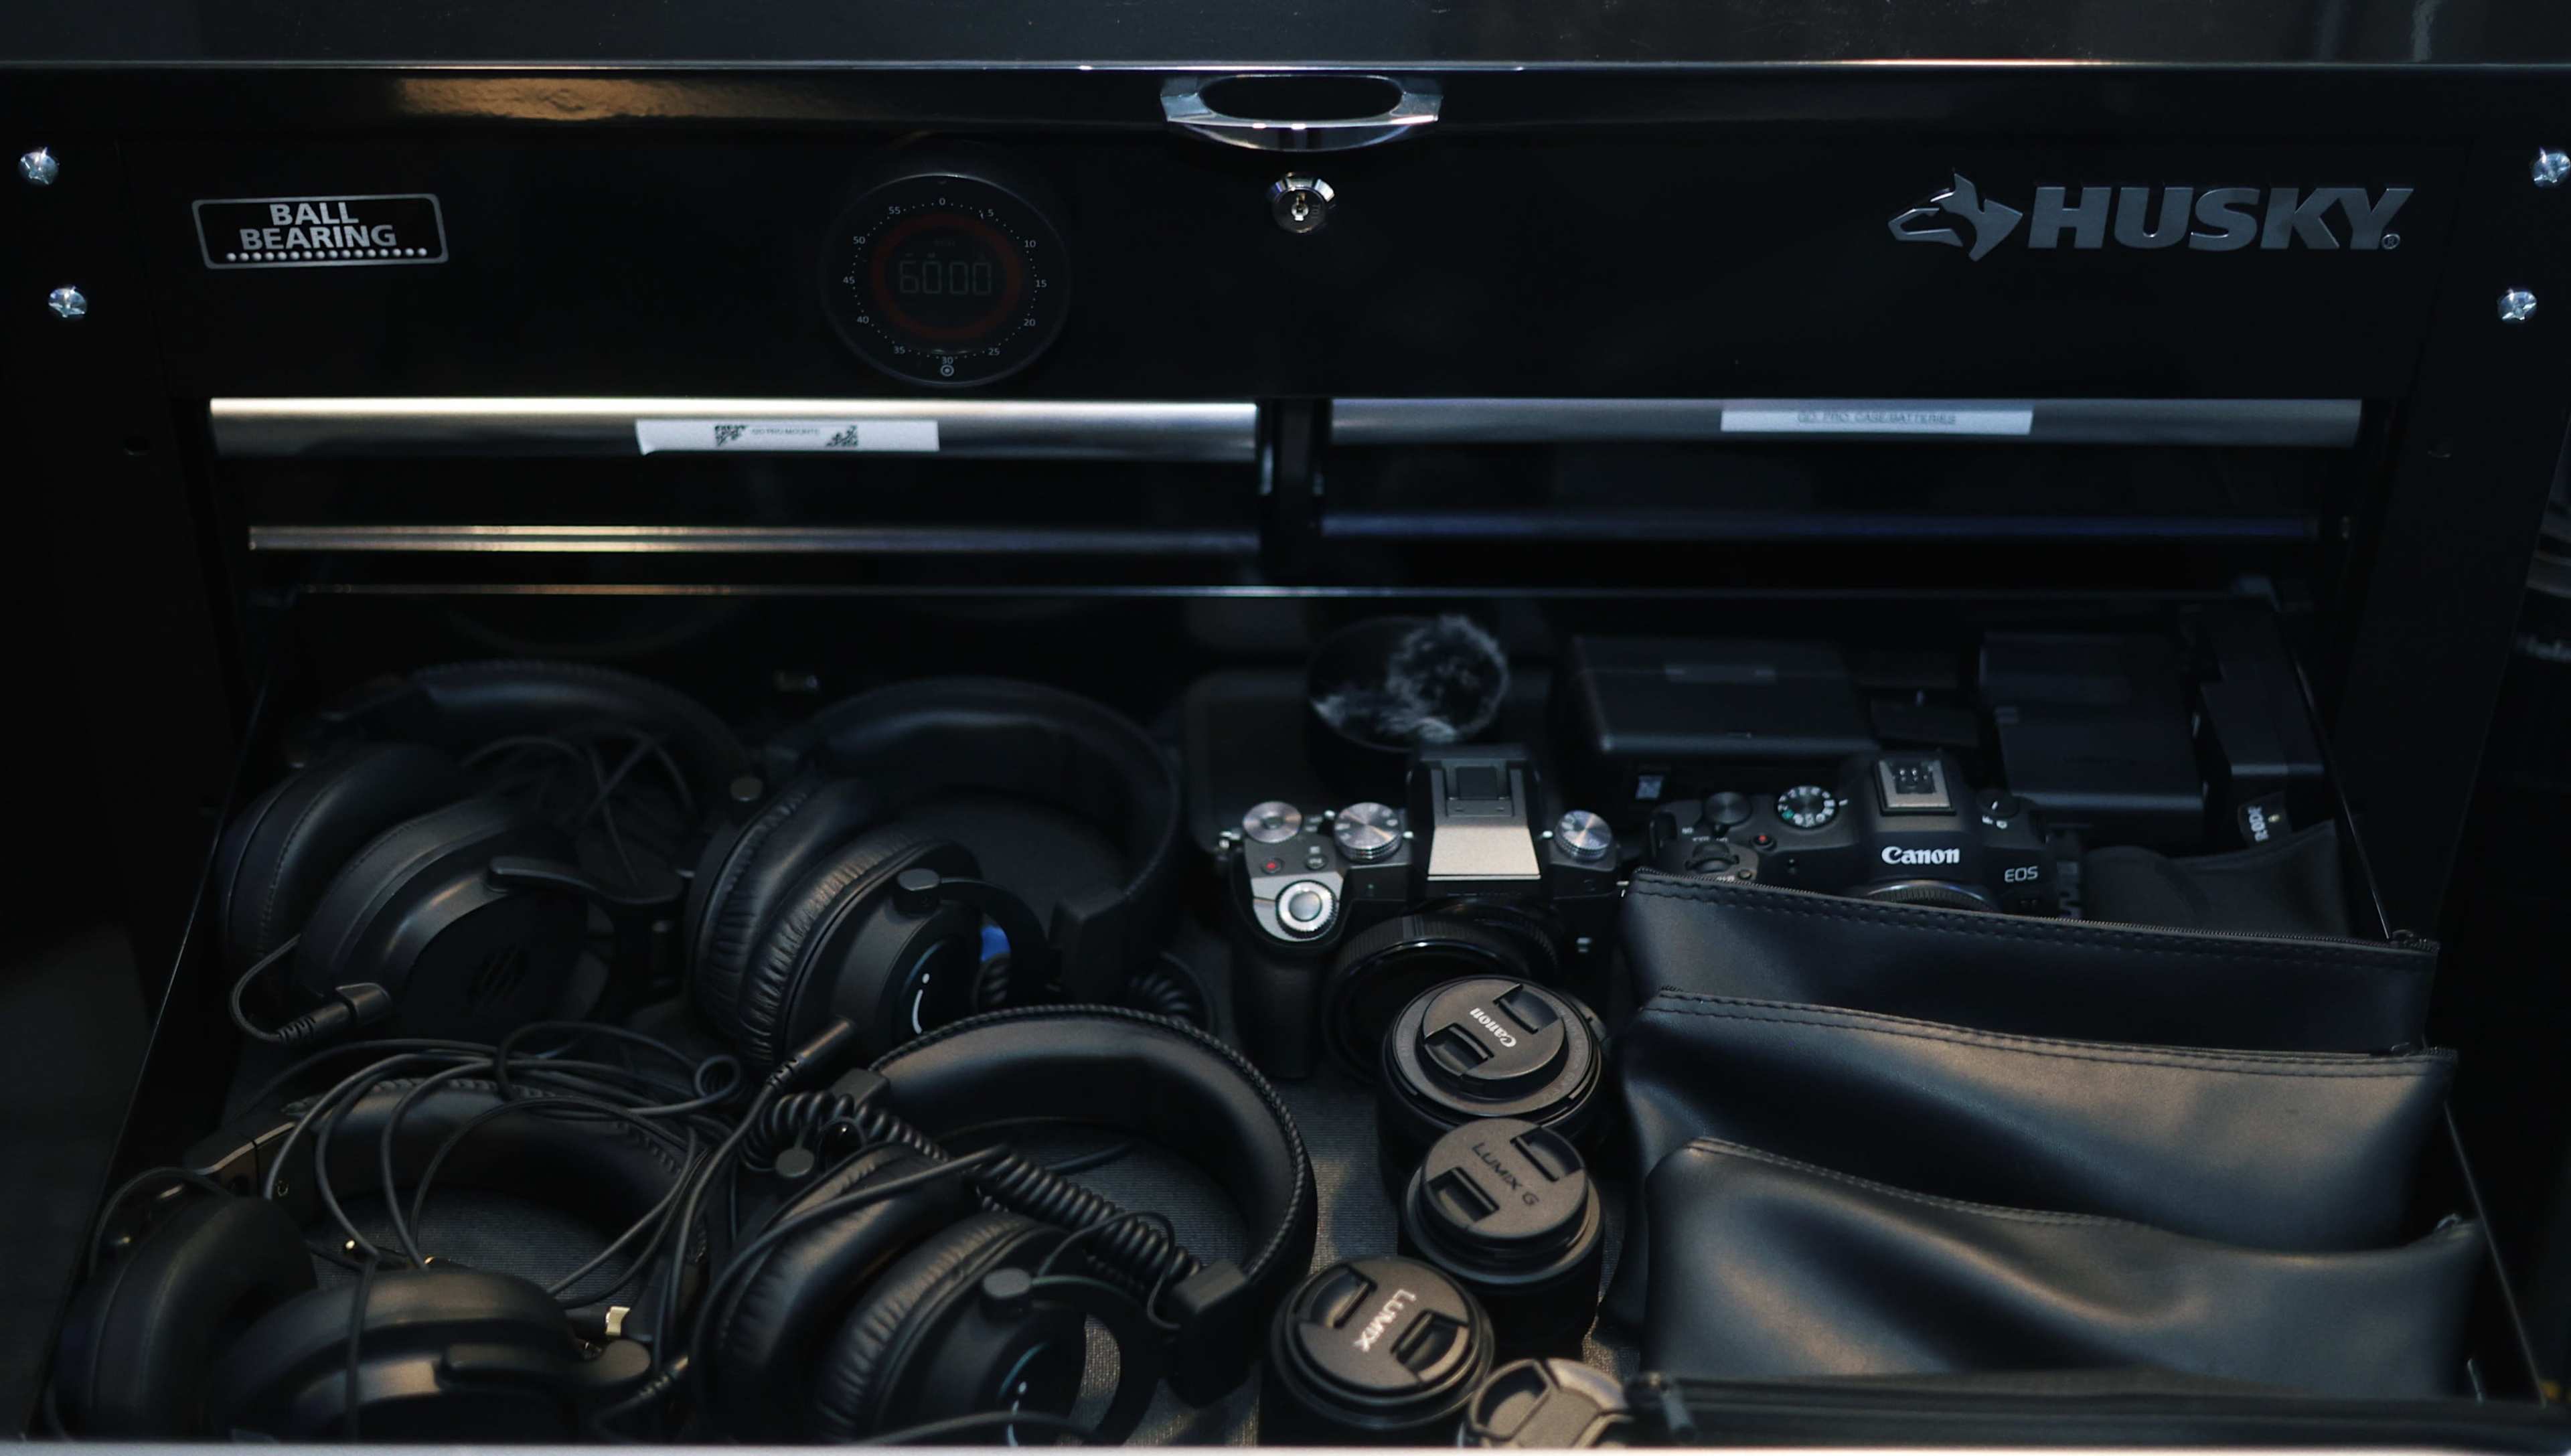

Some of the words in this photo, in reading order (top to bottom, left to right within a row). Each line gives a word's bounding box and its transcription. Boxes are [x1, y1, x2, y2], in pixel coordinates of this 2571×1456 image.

[939, 197, 946, 206] 0
[268, 201, 360, 226] BALL
[888, 206, 901, 215] 55
[988, 208, 994, 217] 5
[2027, 185, 2414, 252] HUSKY
[239, 224, 398, 250] BEARING
[853, 236, 866, 244] 50
[1024, 240, 1036, 248] 10
[842, 276, 856, 285] 45
[1035, 279, 1048, 288] 15
[856, 315, 870, 324] 40
[1023, 318, 1036, 327] 20
[894, 345, 906, 354] 35
[988, 347, 1001, 356] 25
[941, 356, 954, 365] 30
[1881, 845, 1961, 865] Canon
[2003, 866, 2039, 883] EOS
[1469, 1007, 1518, 1048] Canon
[1472, 1142, 1524, 1190] LUMIX
[1522, 1192, 1539, 1206] G
[1353, 1289, 1417, 1352] LUMIX
